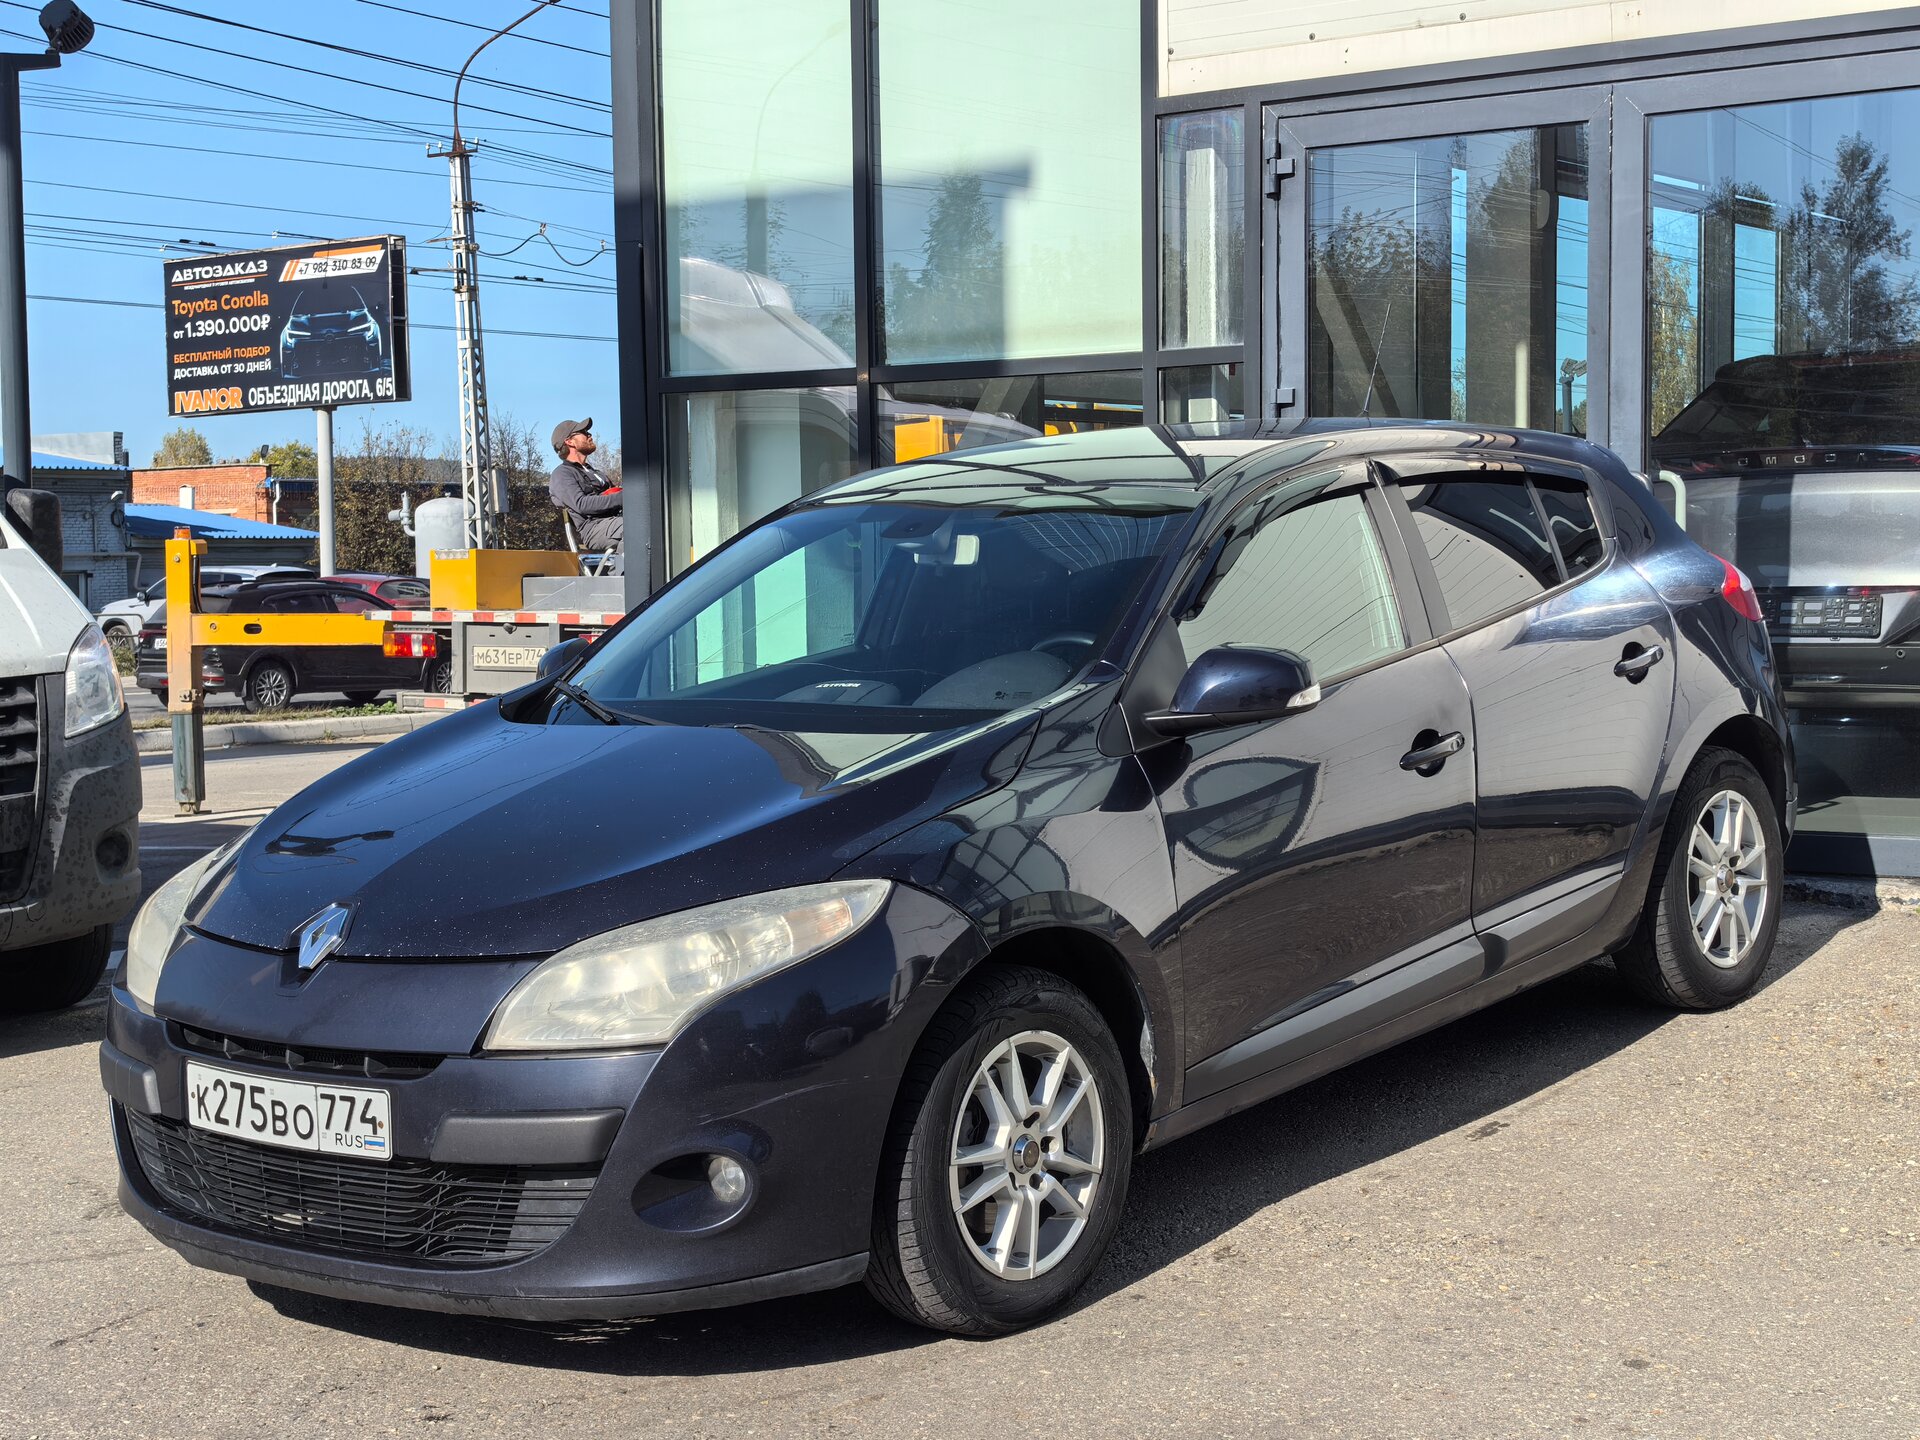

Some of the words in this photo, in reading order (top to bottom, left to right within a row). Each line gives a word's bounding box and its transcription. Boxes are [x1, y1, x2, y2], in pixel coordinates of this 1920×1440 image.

[172, 259, 268, 283] АВТОЗАКАЗ
[298, 263, 310, 275] +7
[312, 261, 329, 274] 982
[332, 259, 348, 272] 310
[351, 257, 362, 269] 83
[365, 256, 377, 268] 09
[172, 297, 218, 318] Toyota
[221, 290, 269, 310] Corolla
[173, 330, 185, 339] от
[173, 347, 232, 364] БЕСПЛАТНЫЙ
[233, 345, 271, 359] ПОДБОР
[173, 364, 220, 380] ДОСТАВКА
[220, 363, 233, 375] ОТ
[233, 363, 245, 374] 30
[246, 358, 272, 374] ДНЕЙ
[174, 386, 244, 414] IVANOR
[248, 383, 320, 407] ОБЪЕЗДНАЯ
[322, 378, 374, 405] ДОРОГА,
[376, 377, 393, 397] 6/5
[476, 648, 523, 665] М631ЕР
[196, 1078, 314, 1140] К275ВО
[319, 1093, 378, 1136] 774
[335, 1132, 363, 1149] RUS
